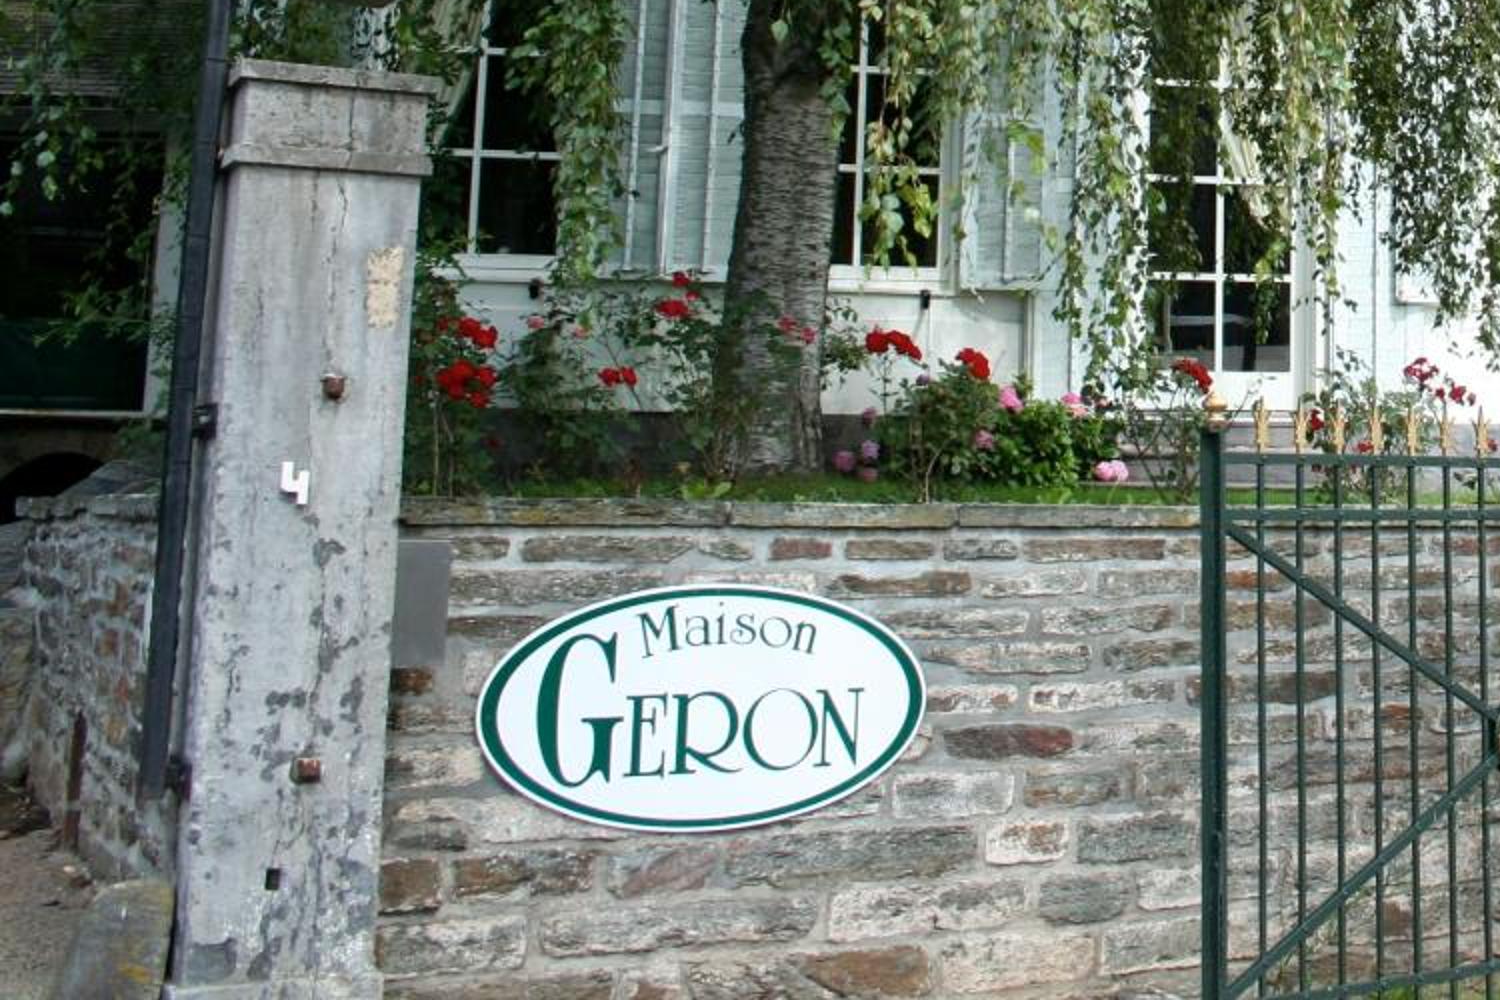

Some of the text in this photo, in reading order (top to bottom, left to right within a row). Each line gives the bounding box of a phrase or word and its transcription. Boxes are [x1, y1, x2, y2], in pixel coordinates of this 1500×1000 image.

[280, 461, 310, 505] 4
[638, 601, 817, 659] Maison
[536, 632, 865, 788] GERON
